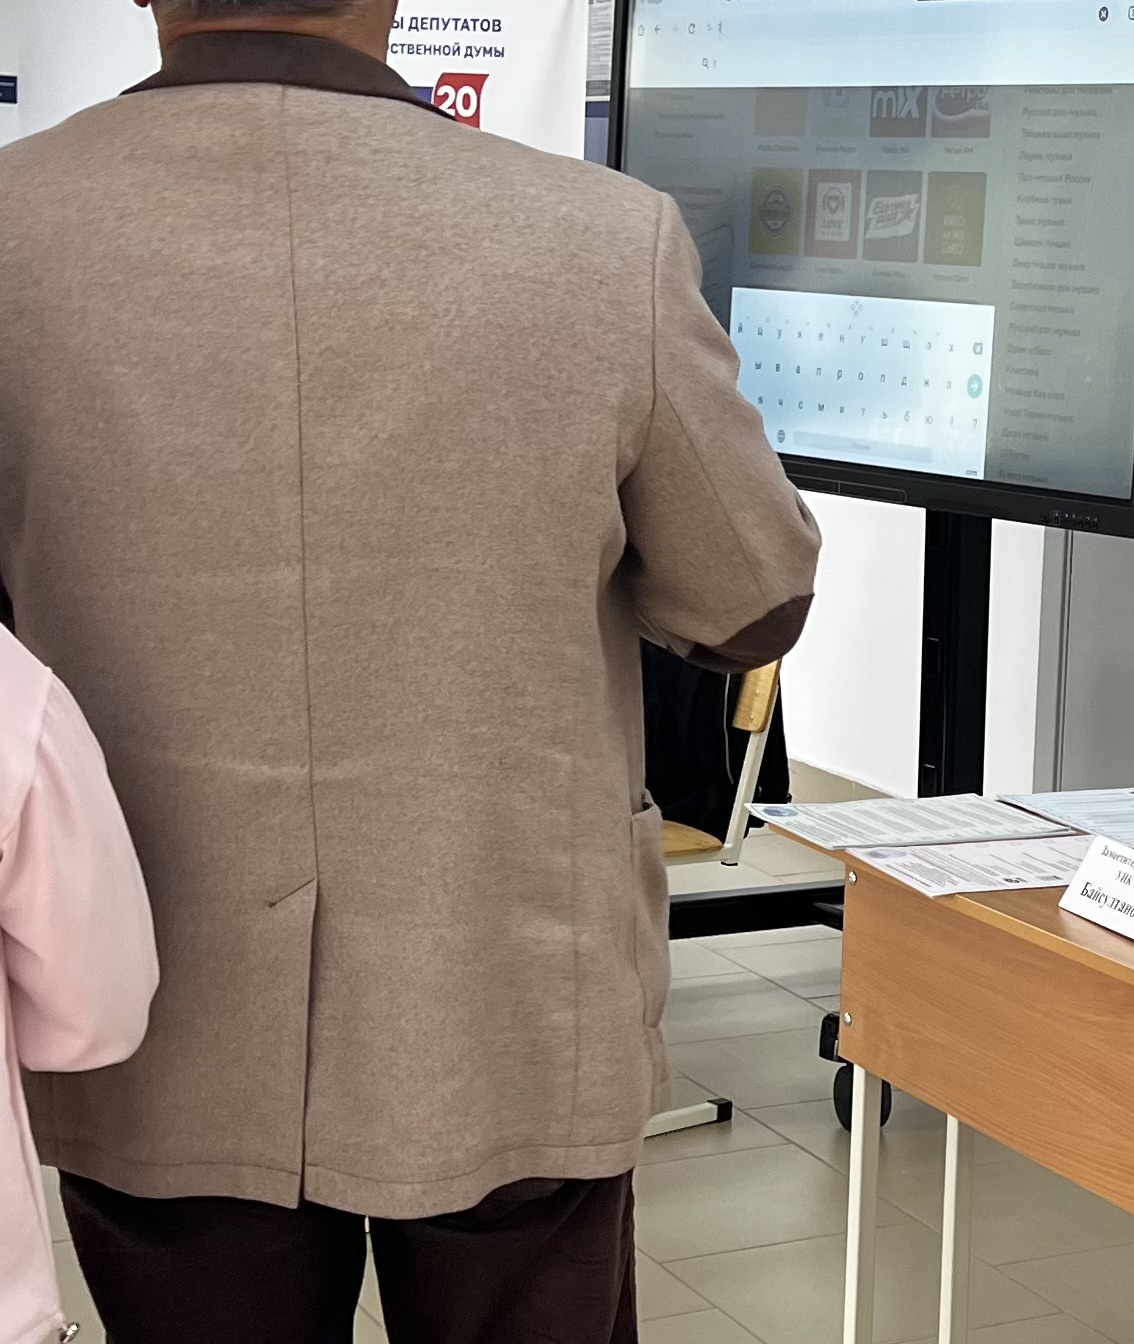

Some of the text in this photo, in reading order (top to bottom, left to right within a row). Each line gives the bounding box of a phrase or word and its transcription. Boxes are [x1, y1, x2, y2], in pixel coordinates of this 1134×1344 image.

[408, 16, 502, 32] ДЕПУТАТОВ
[389, 42, 505, 58] СТВЕННОЙ ДУМЫ
[436, 84, 478, 118] 20
